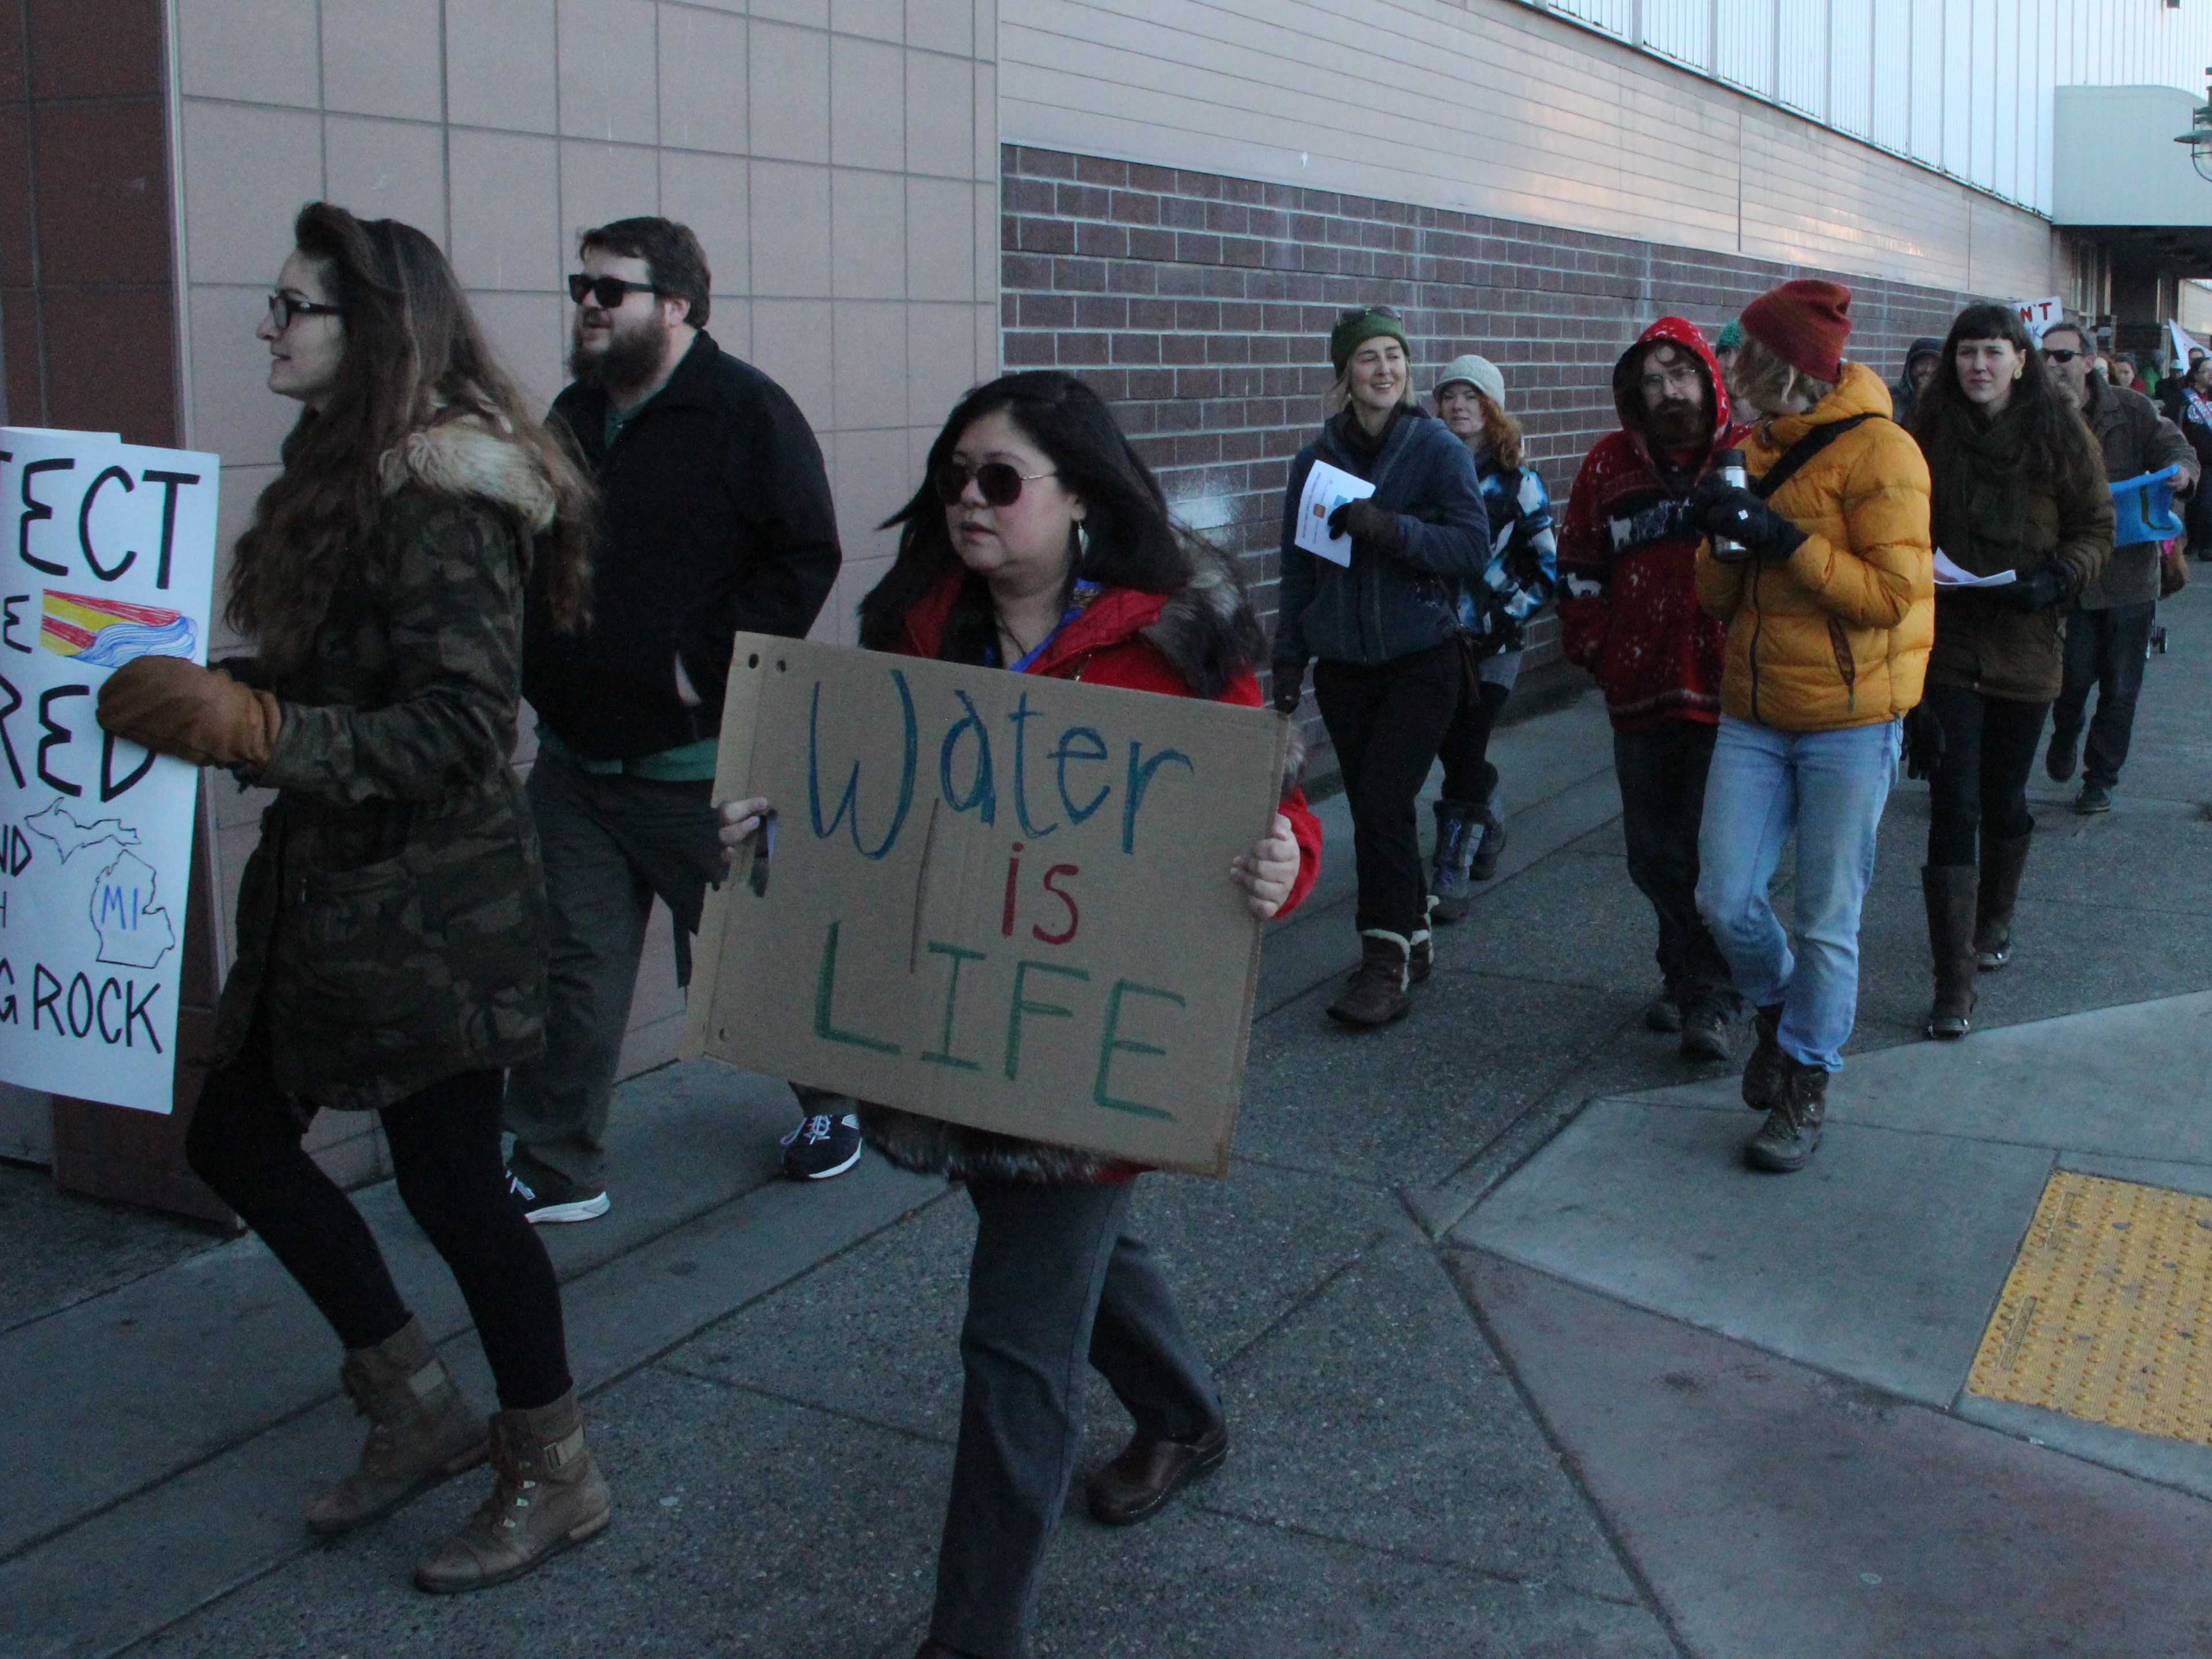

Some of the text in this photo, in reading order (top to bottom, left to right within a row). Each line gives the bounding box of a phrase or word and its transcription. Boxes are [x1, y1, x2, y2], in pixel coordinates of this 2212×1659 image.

[0, 450, 201, 590] ECT
[809, 668, 1194, 860] Water
[101, 884, 140, 931] MI
[1001, 842, 1080, 945] is
[33, 963, 164, 1054] ROCK
[814, 921, 1187, 1122] LIFE
